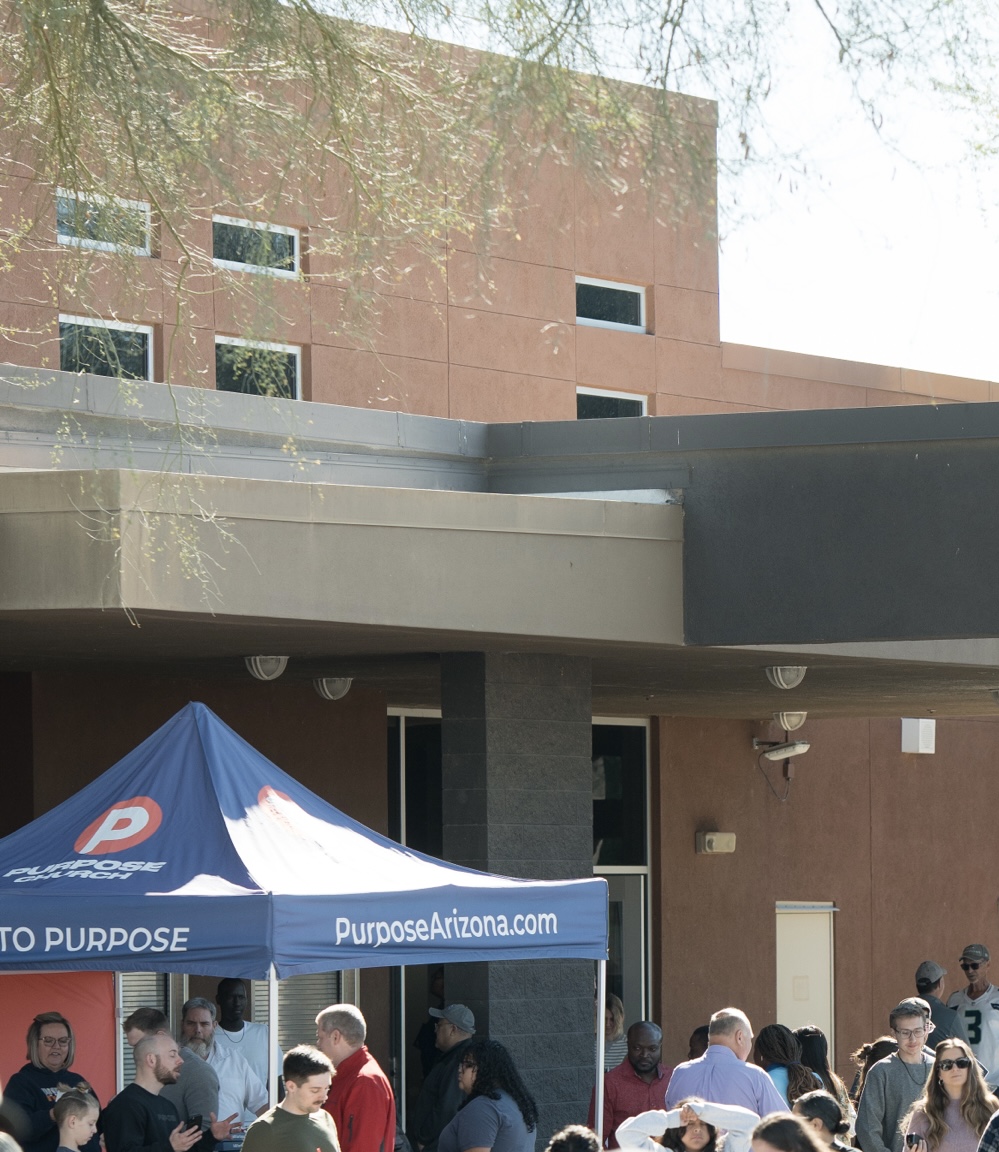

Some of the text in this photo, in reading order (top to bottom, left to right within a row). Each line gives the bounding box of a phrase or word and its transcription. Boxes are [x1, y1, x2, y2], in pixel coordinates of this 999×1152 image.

[79, 806, 149, 854] P
[3, 860, 166, 877] PURPOSE
[13, 870, 133, 883] CHURCH
[44, 927, 190, 952] PURPOSE
[335, 908, 558, 948] PurposeArizona.com
[965, 1010, 982, 1044] 3
